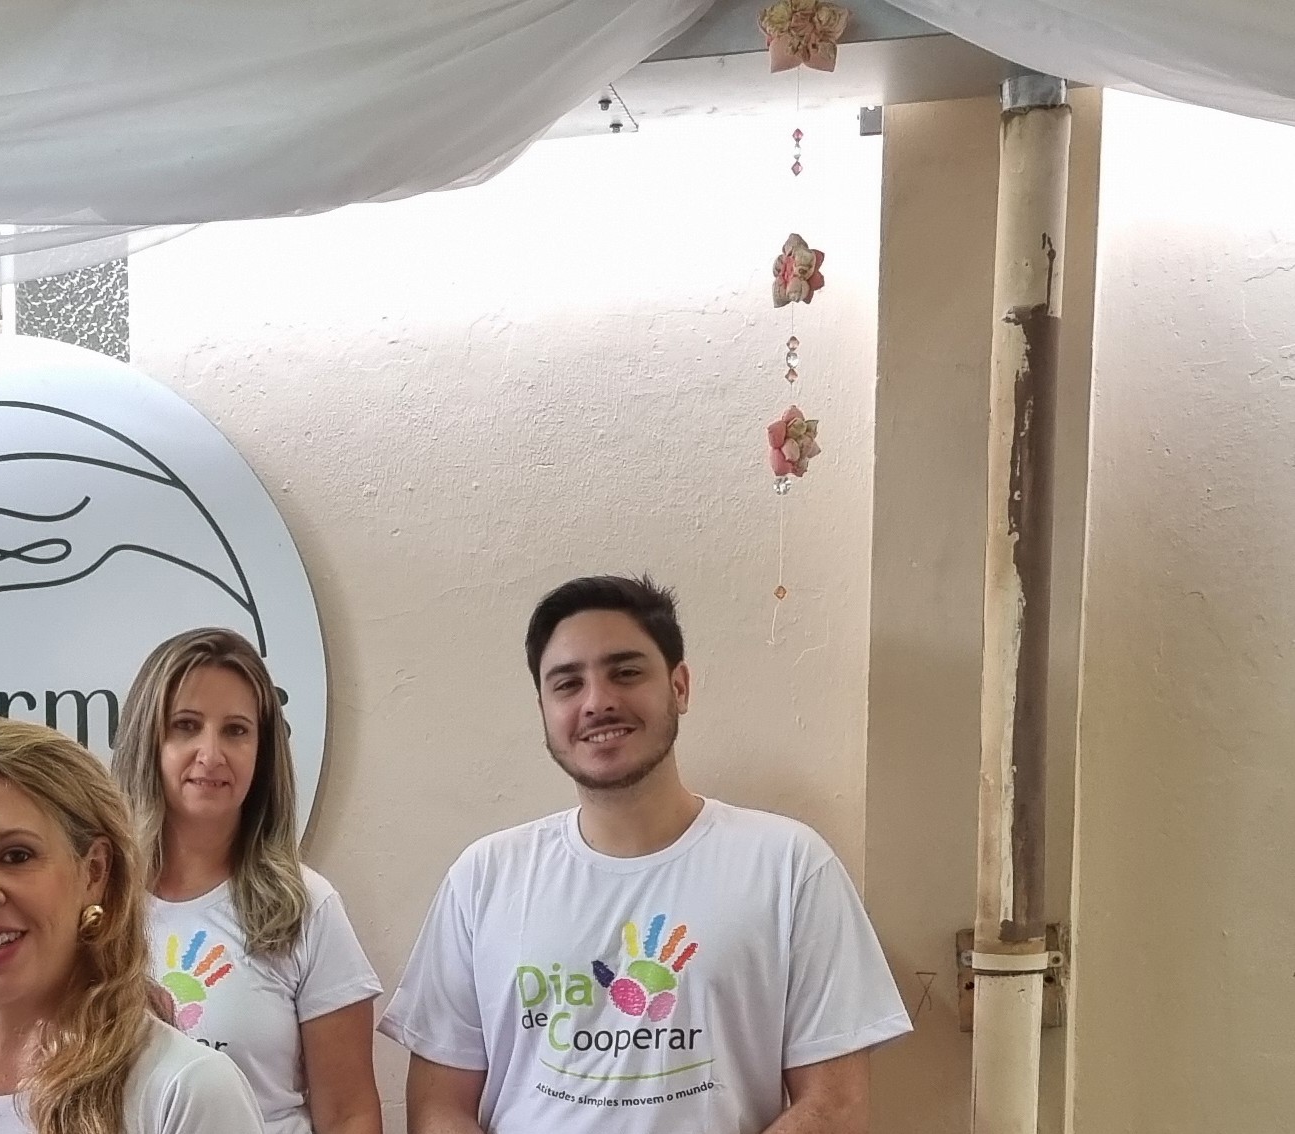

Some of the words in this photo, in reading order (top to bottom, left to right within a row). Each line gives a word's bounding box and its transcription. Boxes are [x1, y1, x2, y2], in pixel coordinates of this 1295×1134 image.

[517, 962, 594, 1008] Dia
[521, 1009, 548, 1029] de
[548, 1012, 702, 1058] Cooperar
[535, 1082, 576, 1103] Atitudes
[578, 1095, 619, 1107] simples
[621, 1096, 664, 1107] movem
[666, 1093, 674, 1102] o
[675, 1081, 714, 1099] mundo
